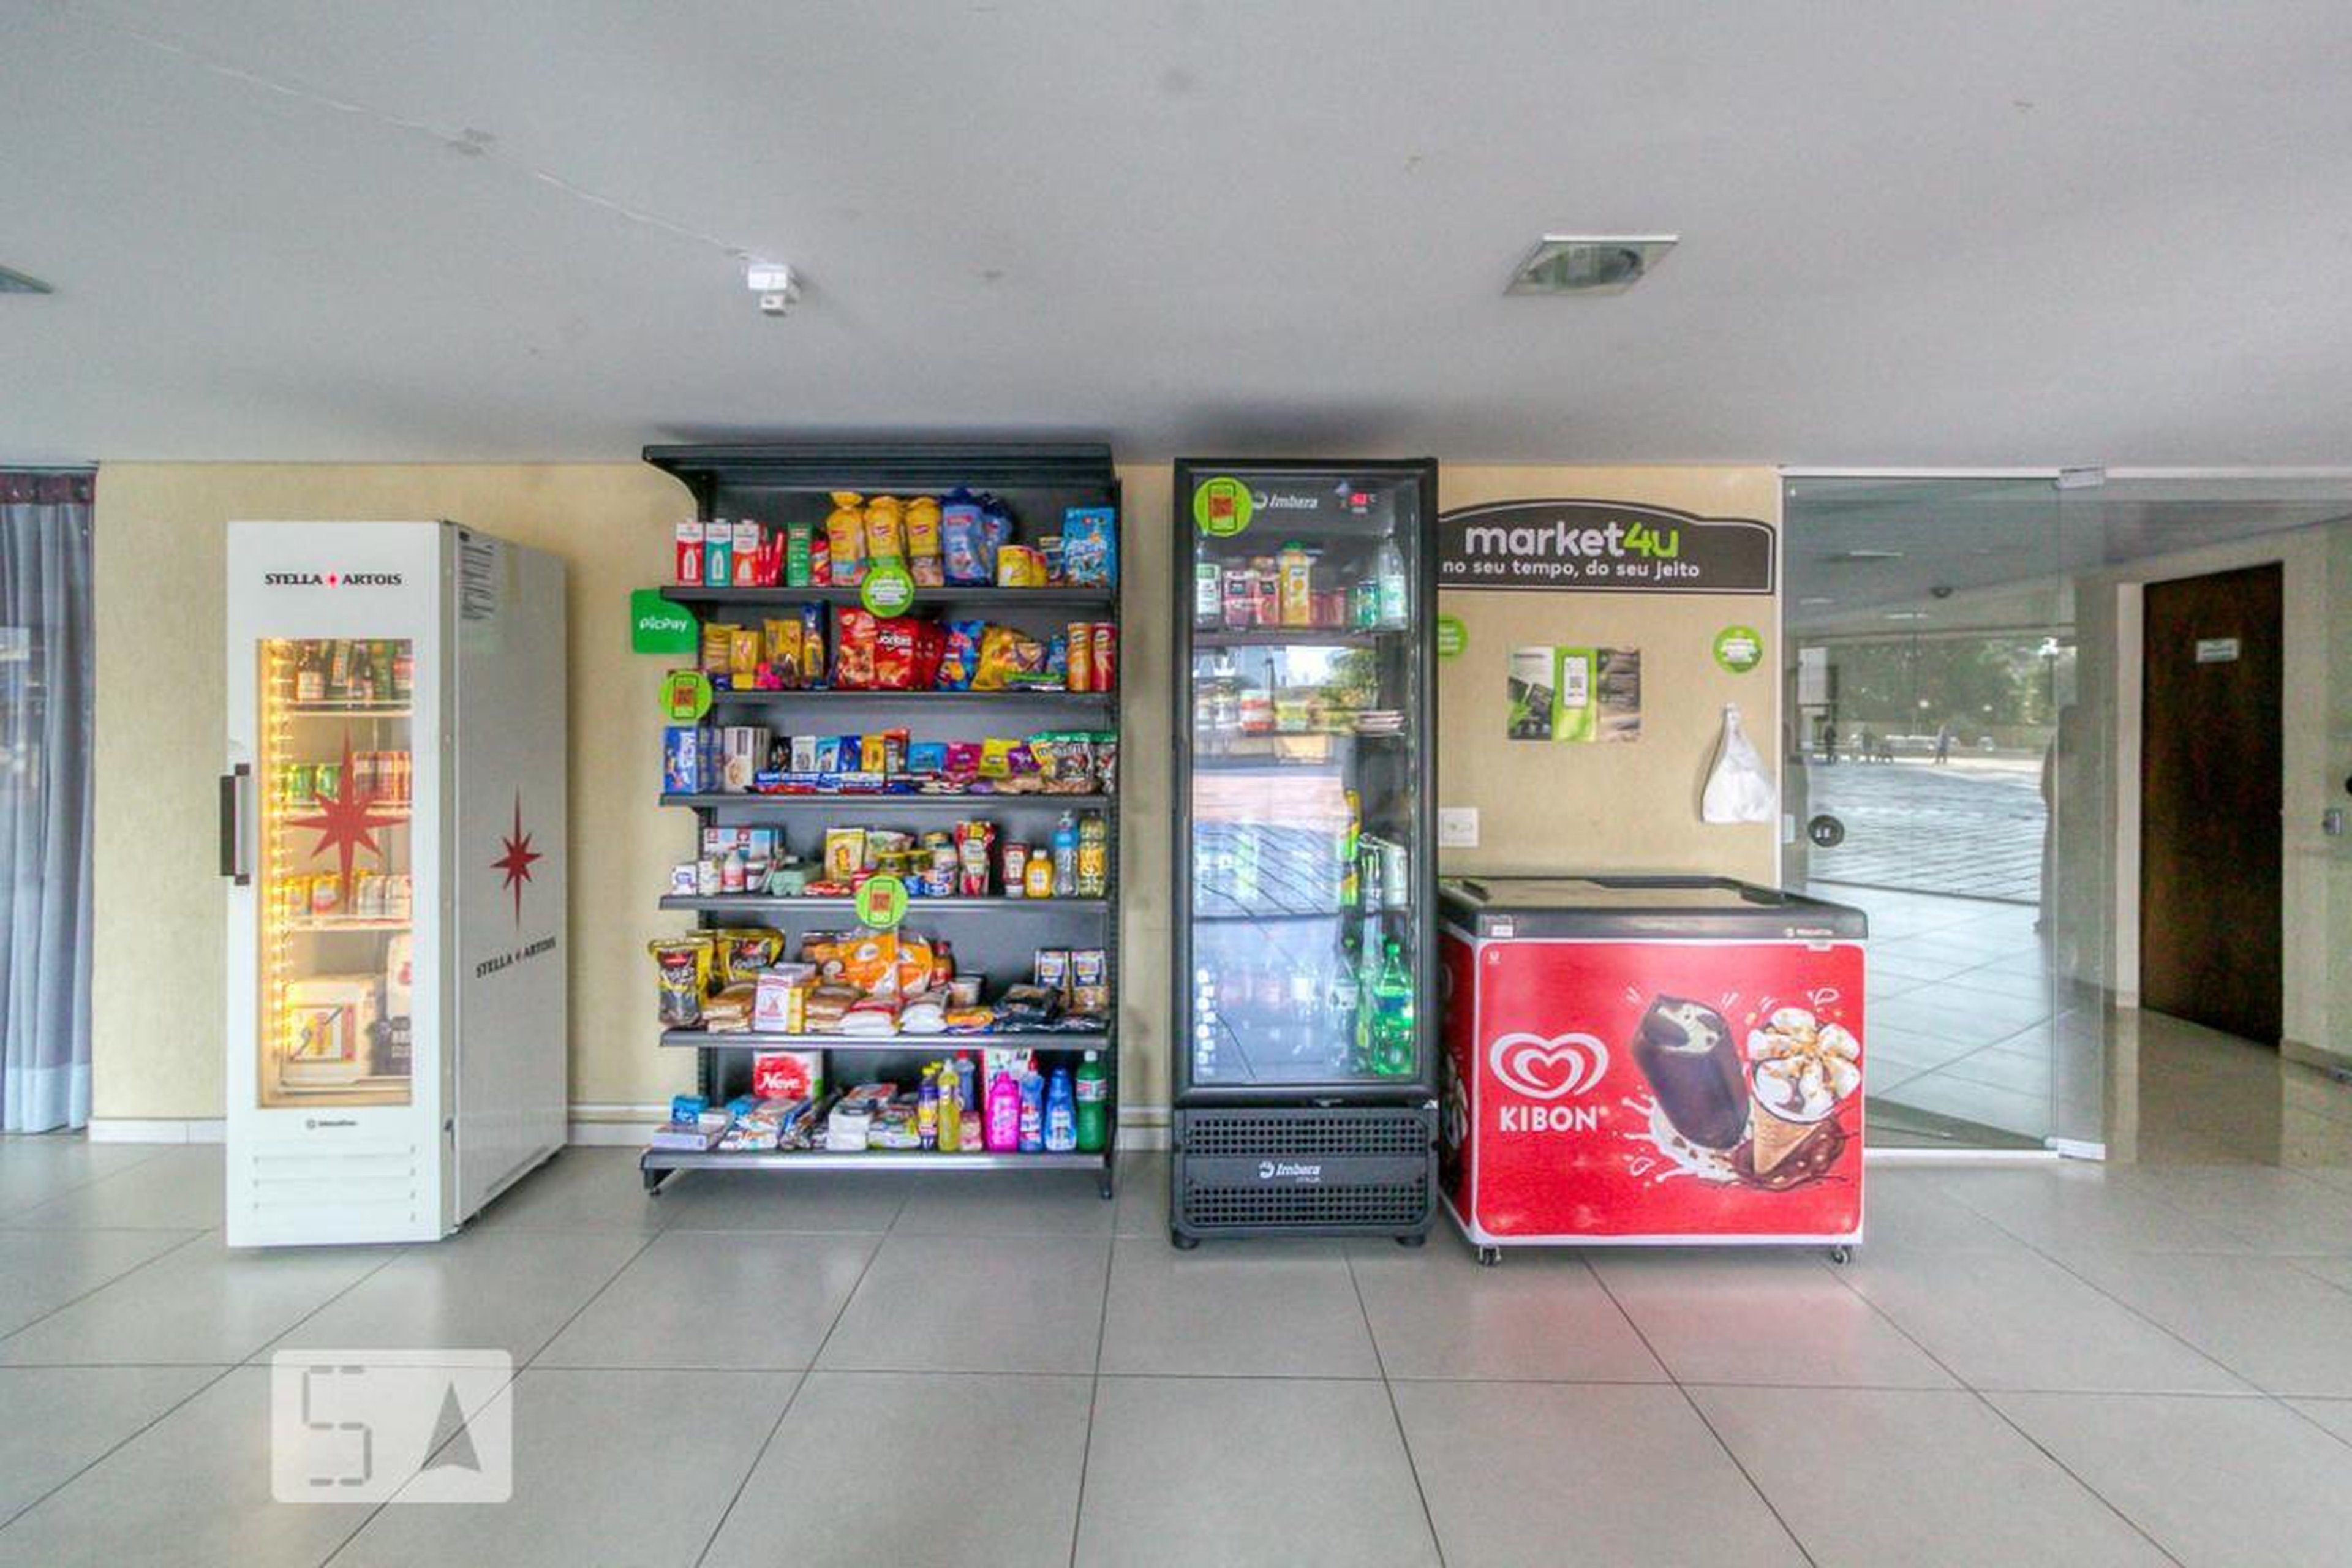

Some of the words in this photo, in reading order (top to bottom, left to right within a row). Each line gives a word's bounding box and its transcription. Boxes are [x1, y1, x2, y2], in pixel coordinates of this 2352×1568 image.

[1269, 494, 1318, 508] Imbera
[1464, 520, 1679, 558] market4u
[1442, 560, 1466, 574] no
[1473, 561, 1506, 575] seu
[1513, 559, 1579, 579] tempo,
[1586, 560, 1609, 576] do
[1616, 562, 1648, 577] seu
[265, 573, 323, 586] STELLA
[342, 573, 402, 586] ARTOIS
[475, 953, 514, 979] STELLA
[524, 936, 556, 957] ARTOIS
[1499, 1106, 1598, 1133] KIBON
[1275, 1163, 1321, 1177] Imbera
